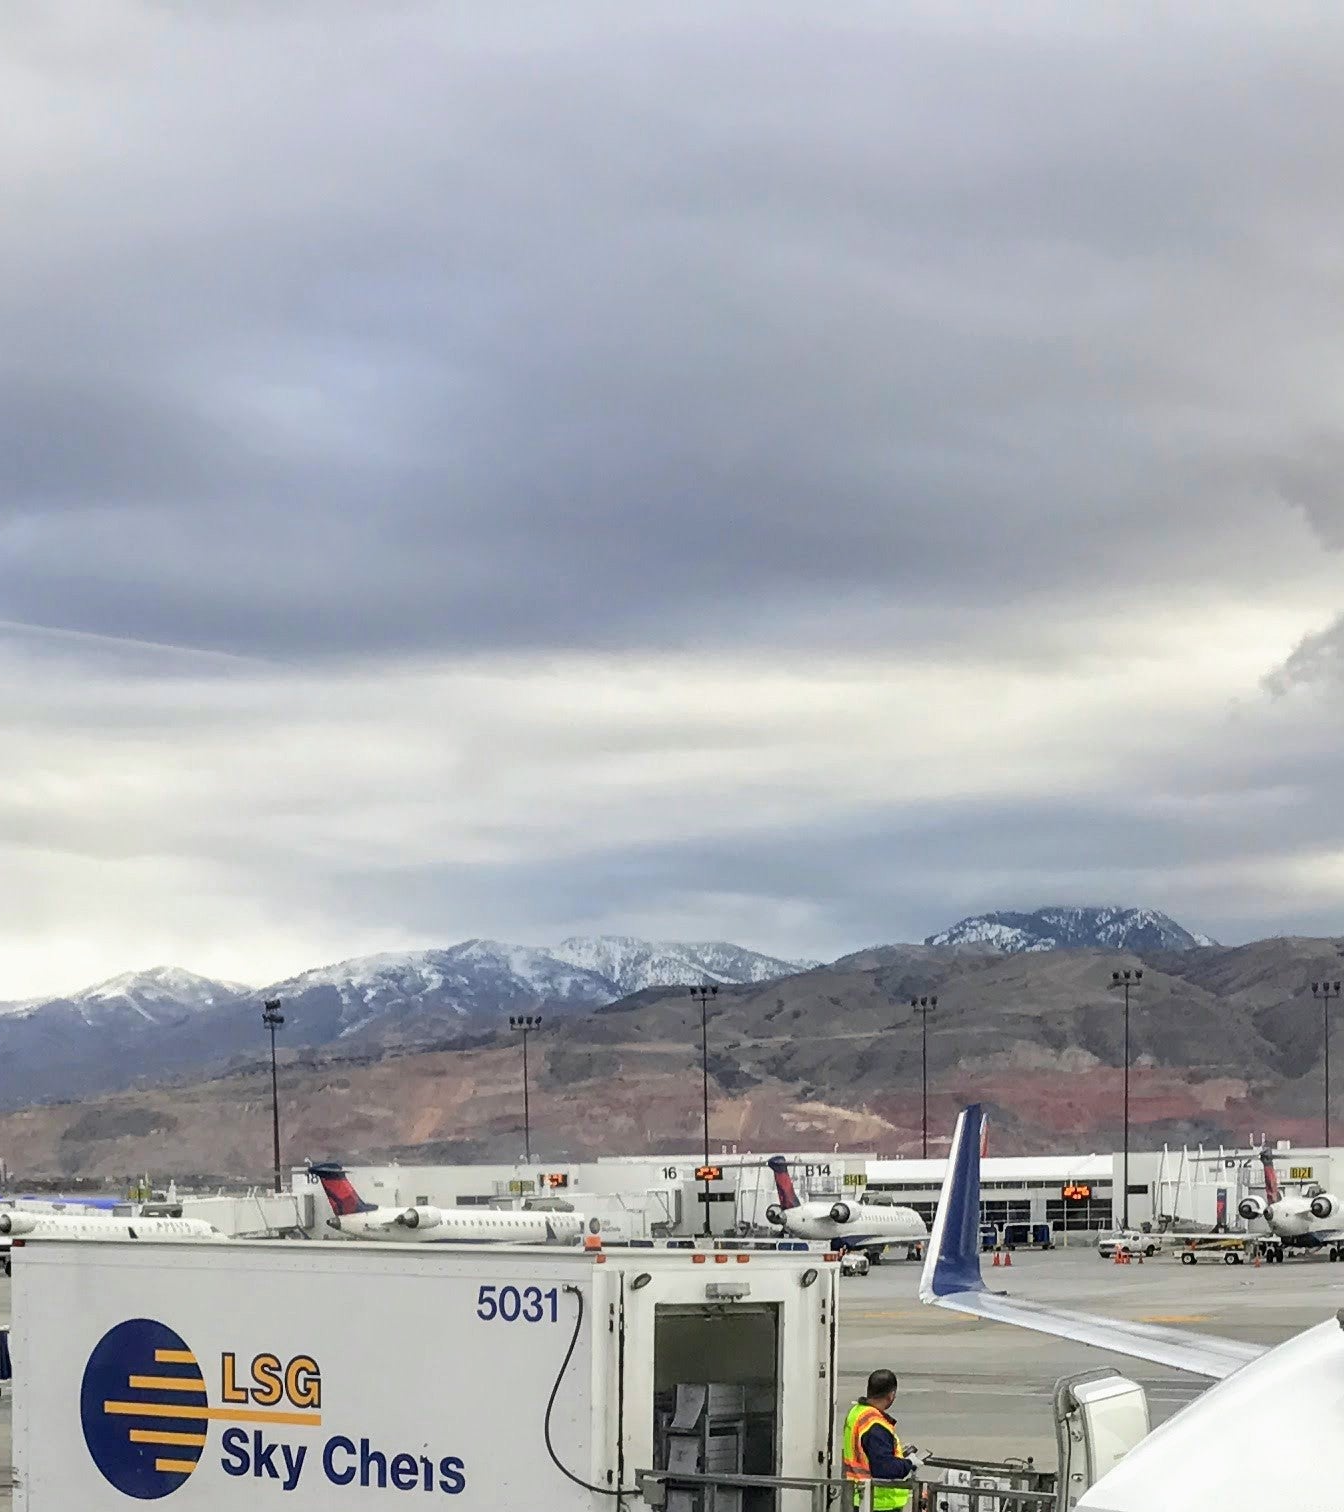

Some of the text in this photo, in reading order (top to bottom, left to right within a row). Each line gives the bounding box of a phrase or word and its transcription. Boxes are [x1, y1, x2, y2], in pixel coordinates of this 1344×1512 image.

[662, 1166, 678, 1180] 16
[476, 1285, 558, 1323] 5031
[221, 1351, 322, 1409] LSG
[220, 1427, 308, 1491] Sky
